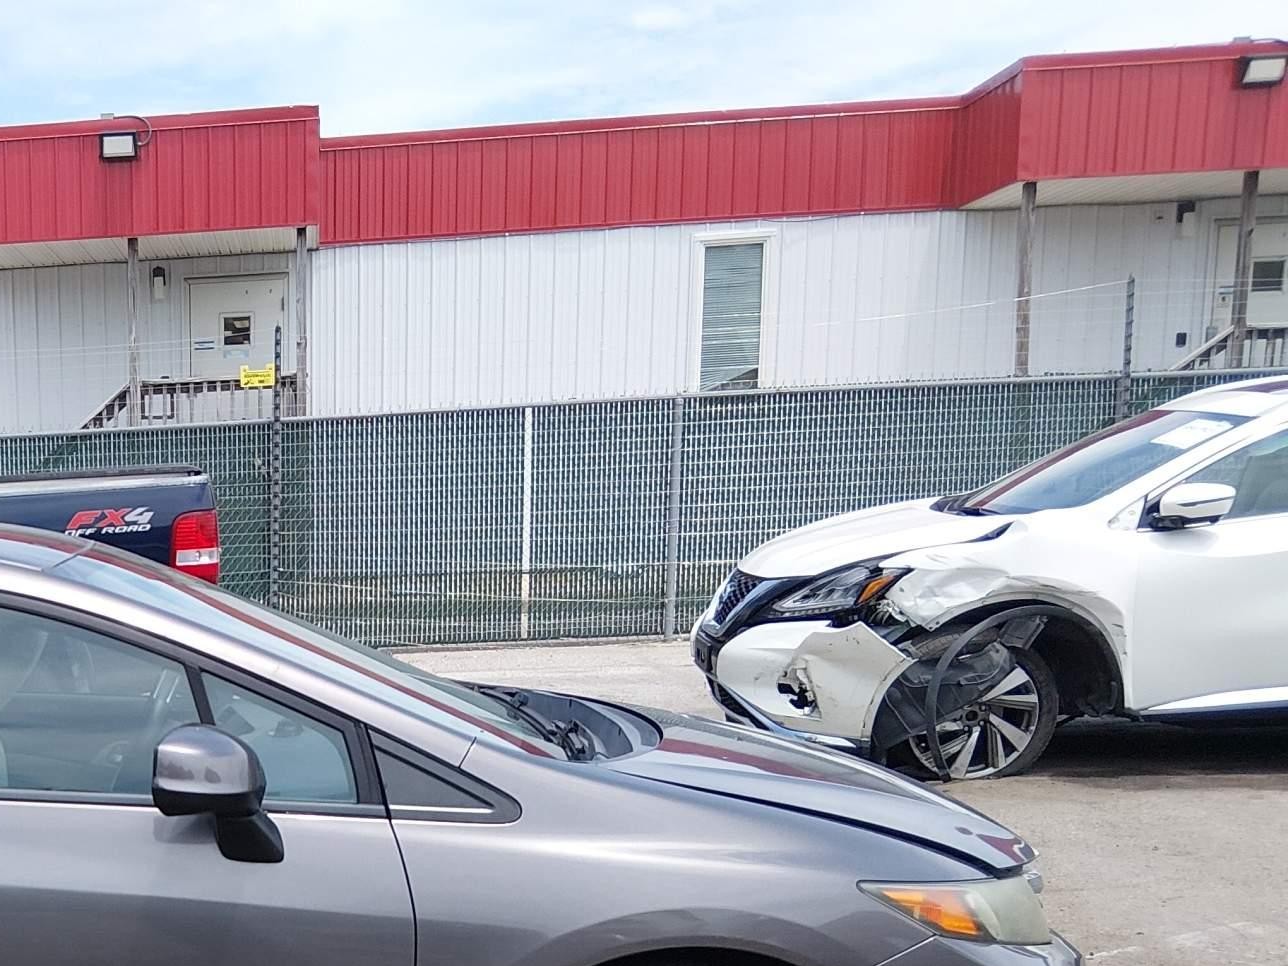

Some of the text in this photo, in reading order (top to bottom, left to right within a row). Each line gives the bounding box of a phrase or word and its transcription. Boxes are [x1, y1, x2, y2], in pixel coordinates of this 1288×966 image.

[66, 507, 154, 529] FX4
[64, 524, 152, 537] OFF ROAD
